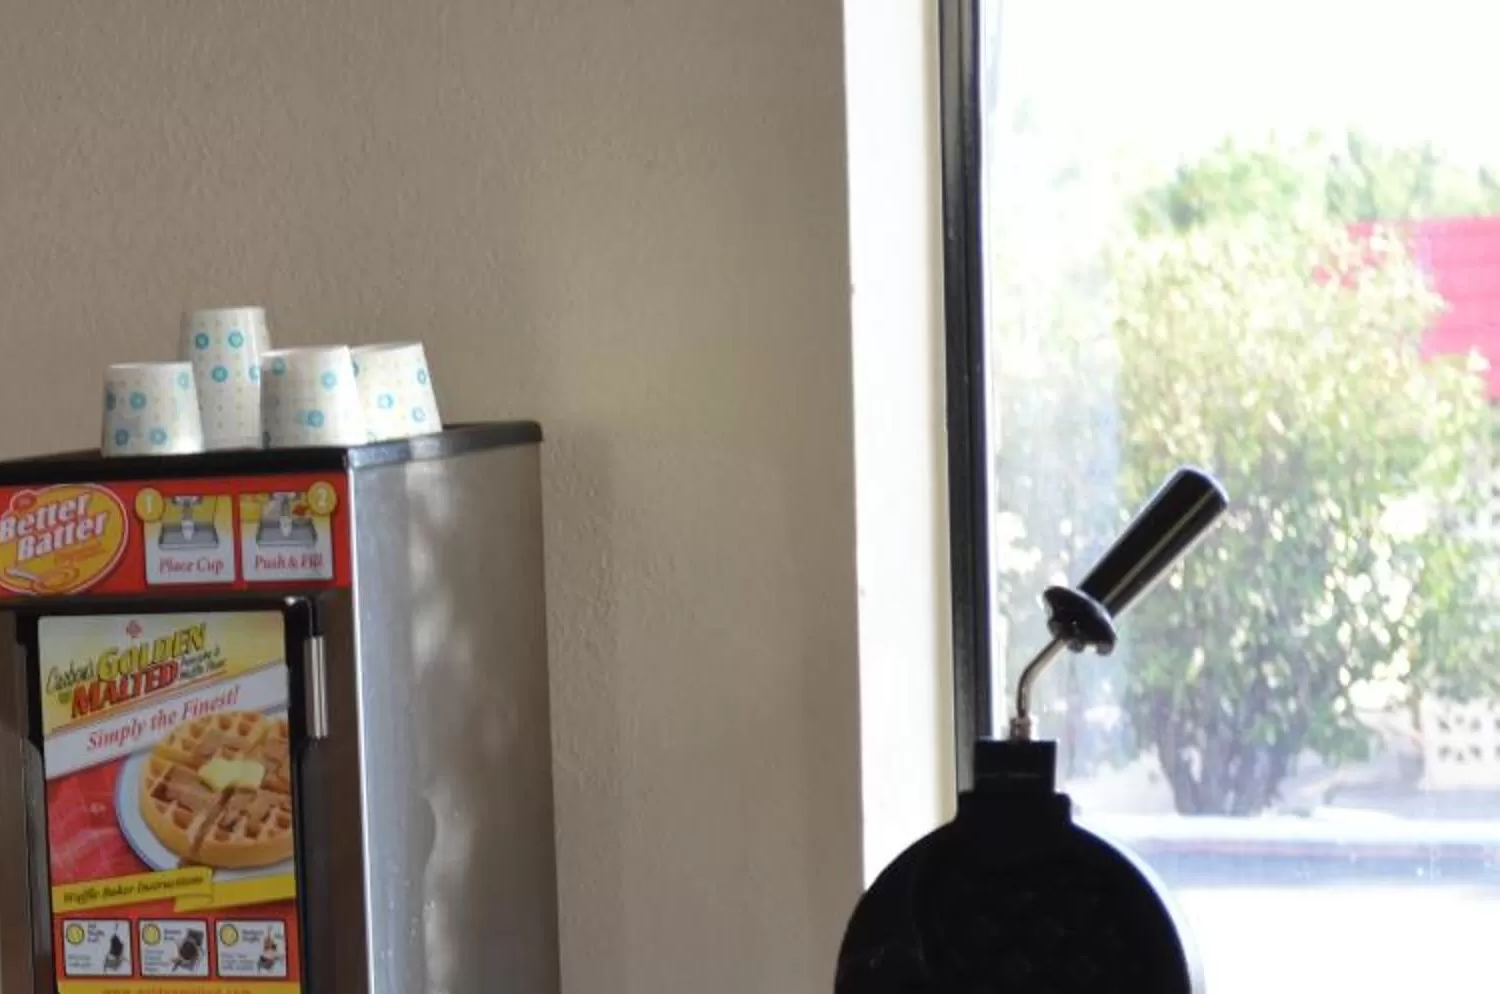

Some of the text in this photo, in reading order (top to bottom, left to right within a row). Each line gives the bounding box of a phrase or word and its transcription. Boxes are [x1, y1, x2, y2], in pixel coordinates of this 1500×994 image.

[17, 513, 107, 562] Batter
[158, 556, 224, 577] Place Cup
[254, 555, 285, 571] Push
[287, 556, 298, 570] &
[96, 622, 206, 680] GOLDEN
[69, 658, 181, 721] MALTED
[86, 685, 241, 753] Simply the Finest!
[63, 885, 99, 904] Waffle
[100, 881, 134, 898] Baker
